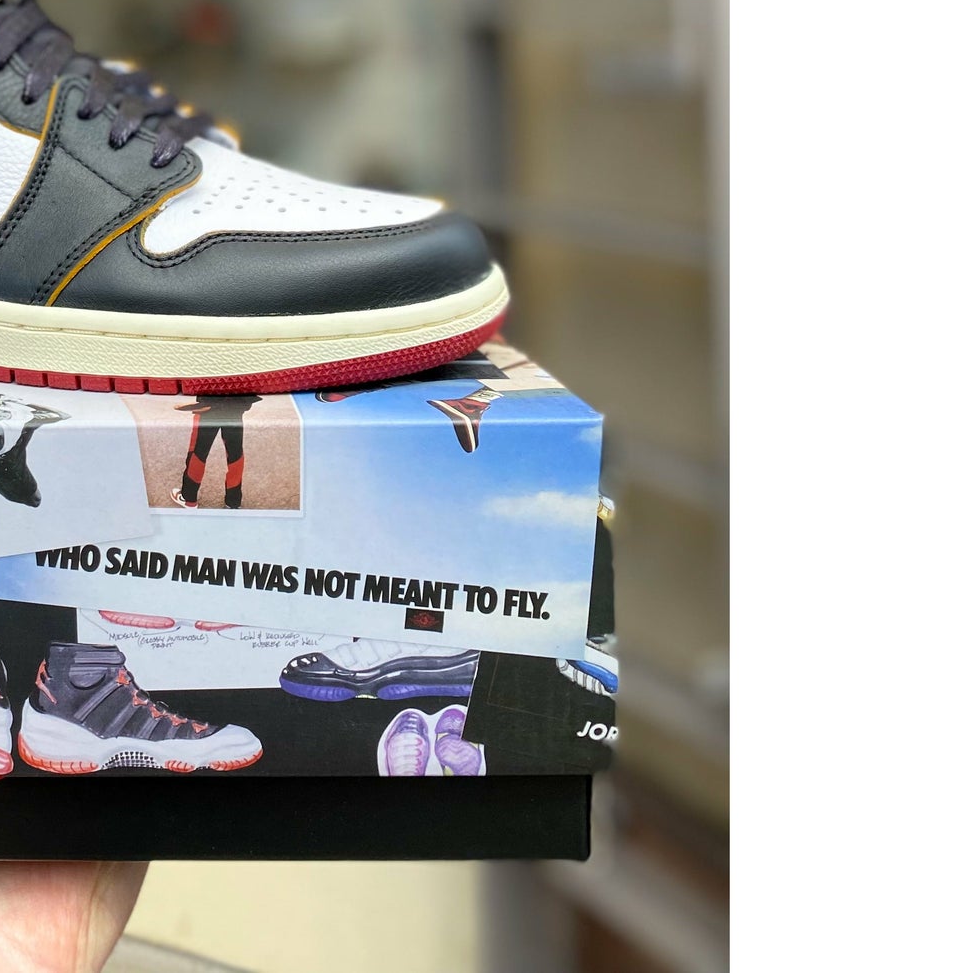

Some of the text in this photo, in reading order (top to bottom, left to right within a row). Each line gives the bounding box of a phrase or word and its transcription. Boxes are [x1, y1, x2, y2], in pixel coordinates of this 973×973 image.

[35, 544, 551, 621] WHO SAID MAN WAS NOT MEANT TO FLY.
